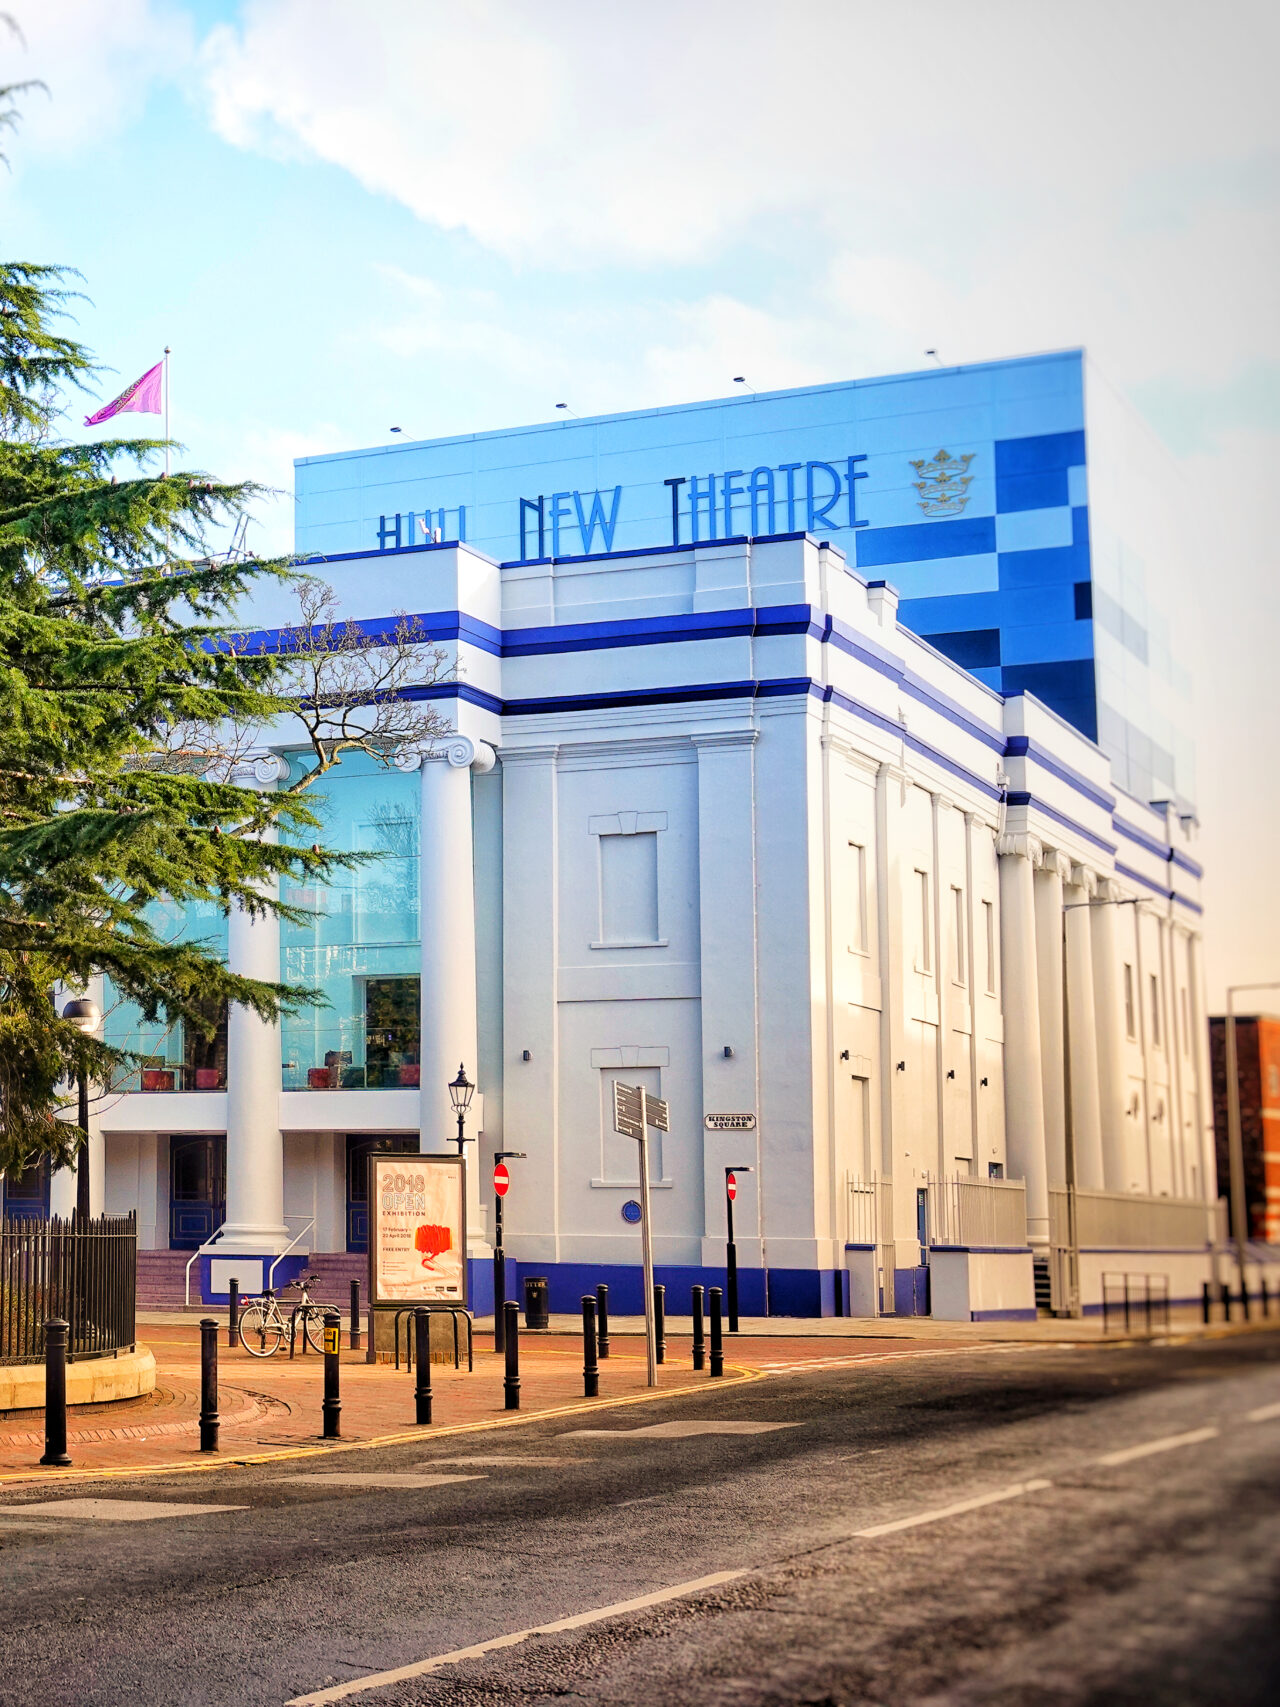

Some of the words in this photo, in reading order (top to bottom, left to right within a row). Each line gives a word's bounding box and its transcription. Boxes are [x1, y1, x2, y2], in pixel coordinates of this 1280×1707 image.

[519, 485, 621, 561] NEW
[663, 454, 870, 548] THEATRE
[382, 1174, 426, 1193] 2018
[382, 1193, 426, 1211] OPEN
